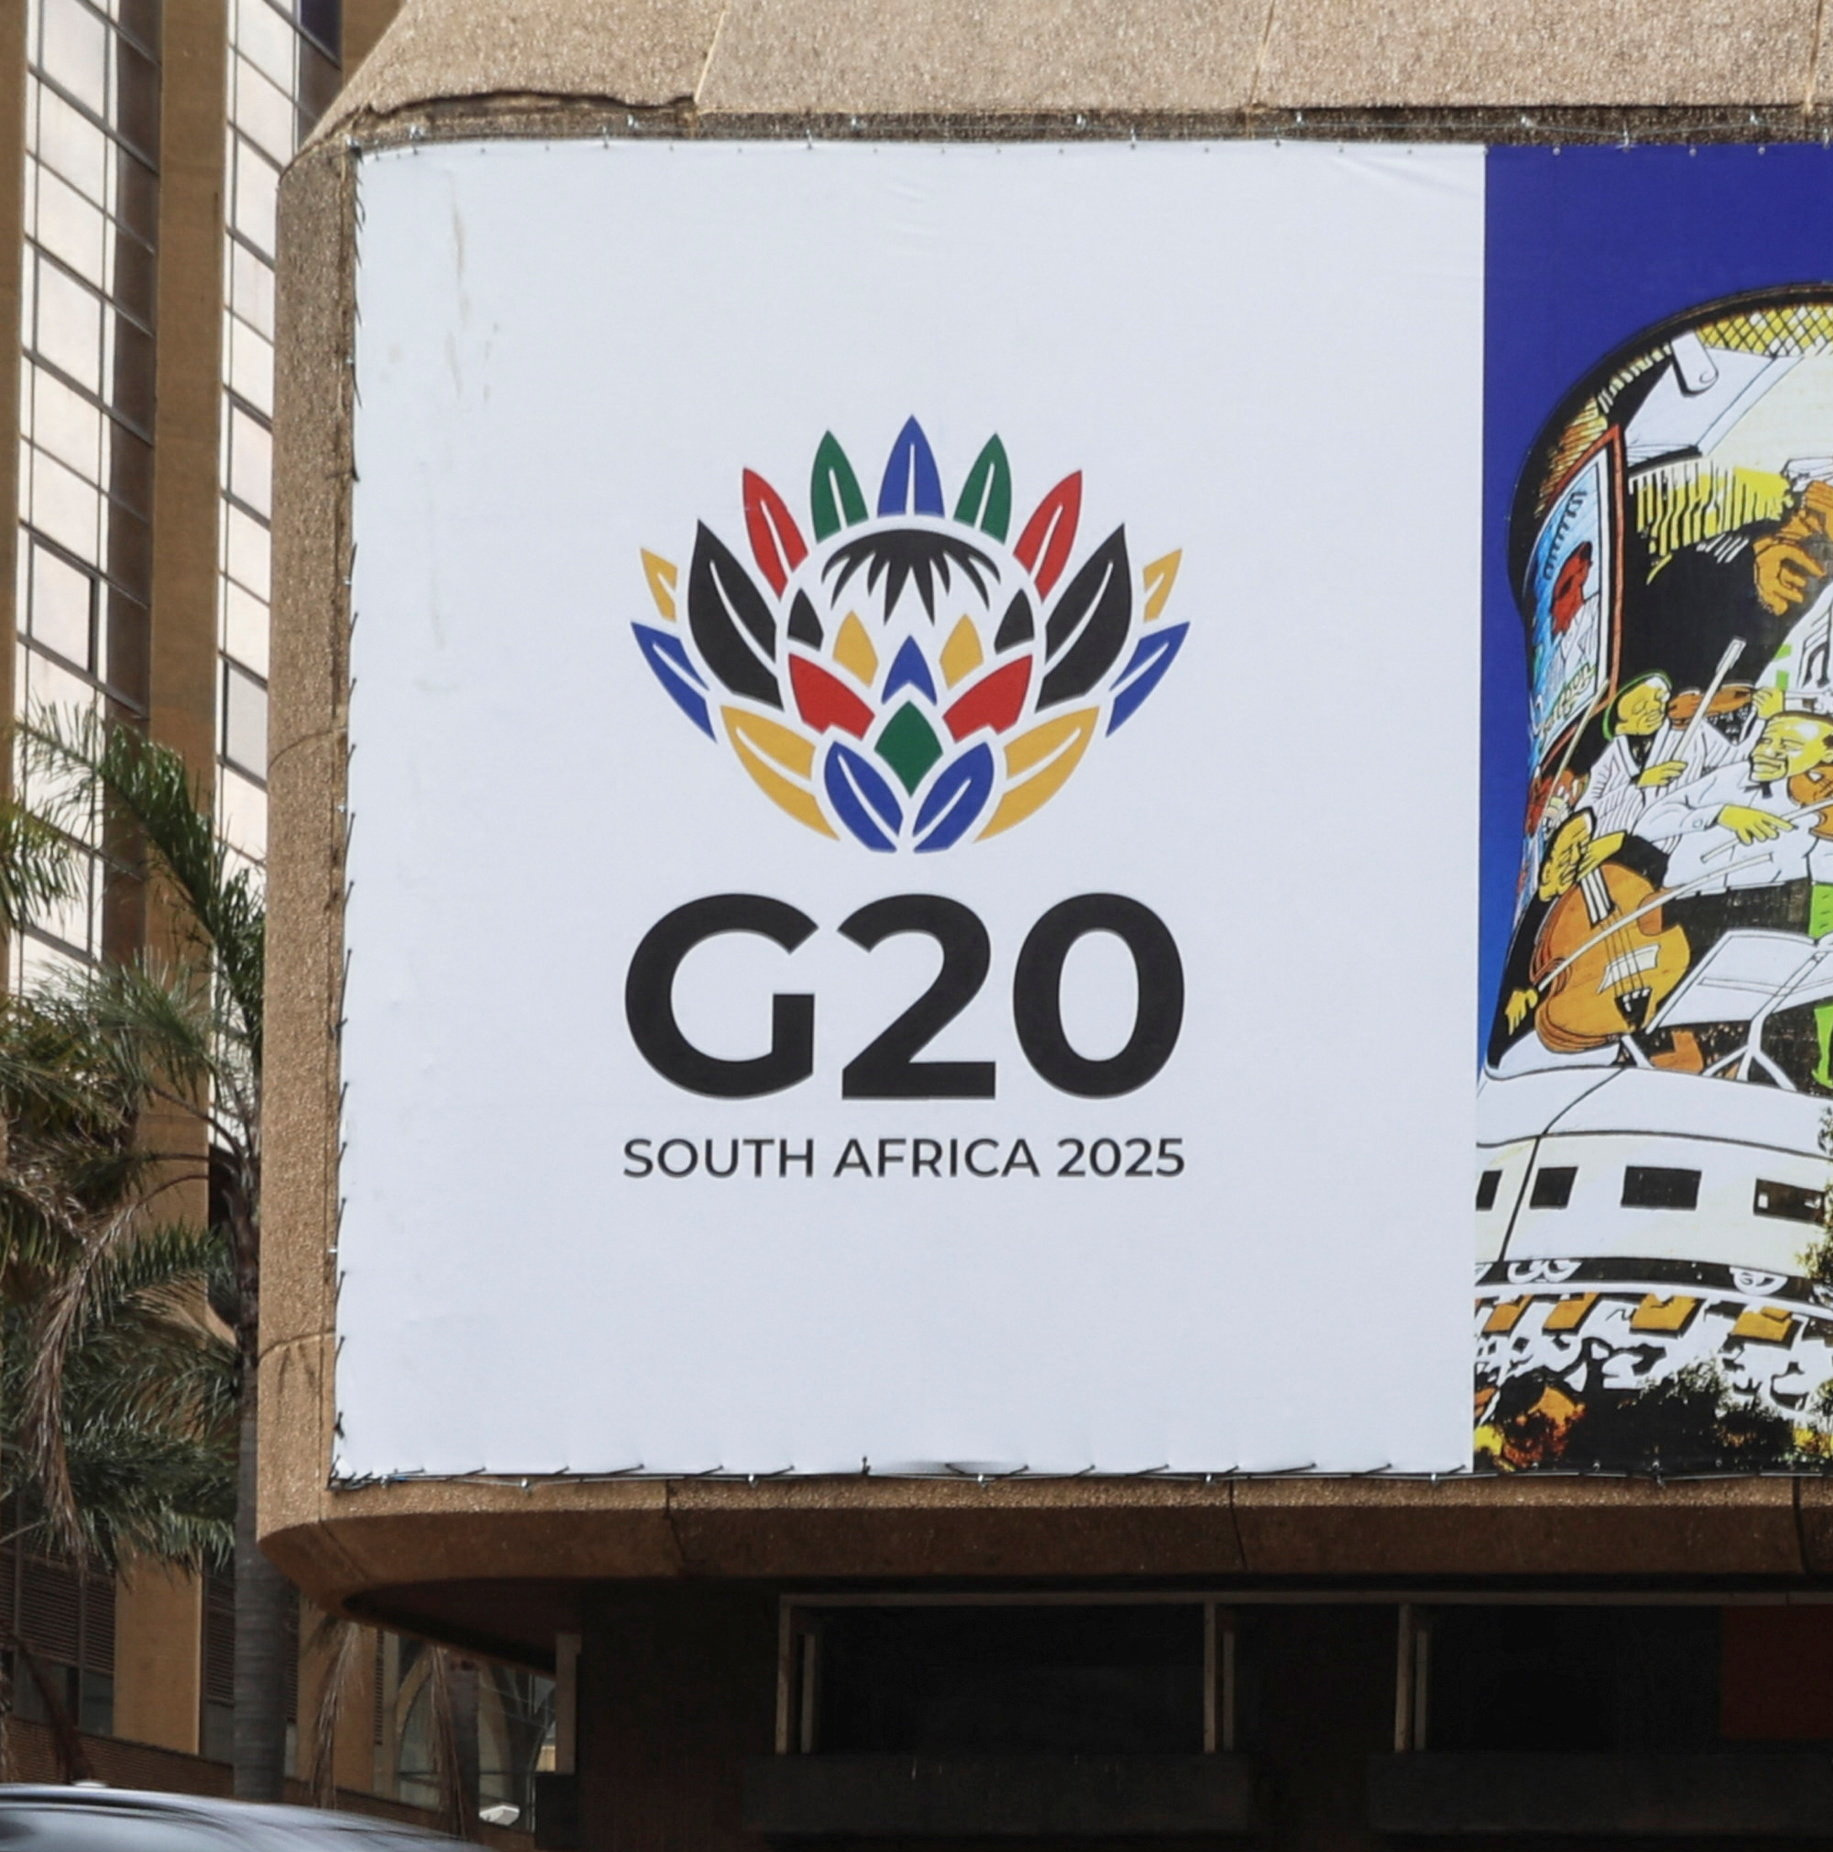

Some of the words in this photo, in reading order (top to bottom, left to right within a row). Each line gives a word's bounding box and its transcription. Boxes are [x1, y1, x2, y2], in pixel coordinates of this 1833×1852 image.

[626, 893, 1184, 1099] G20
[624, 1139, 813, 1177] SOUTH
[834, 1139, 1039, 1177] AFRICA
[1058, 1138, 1184, 1176] 2025
